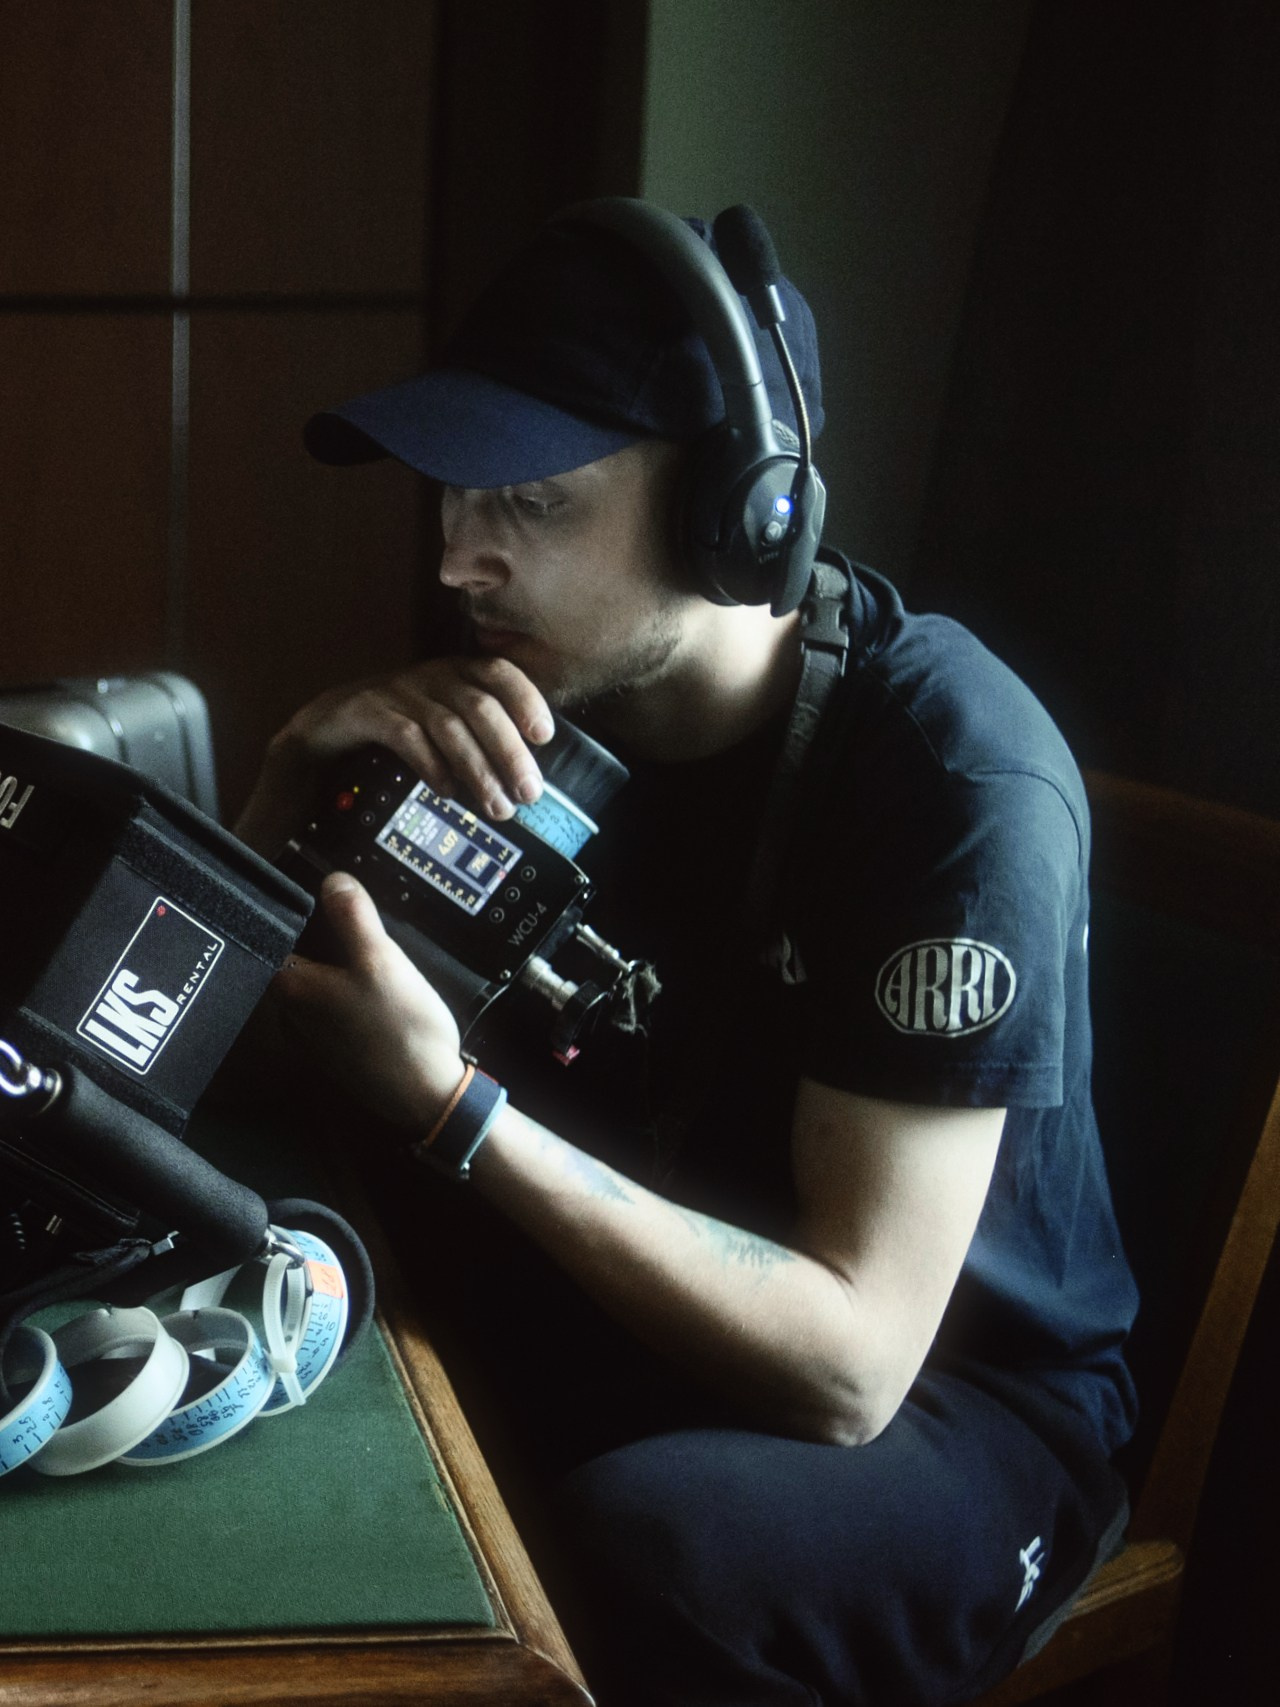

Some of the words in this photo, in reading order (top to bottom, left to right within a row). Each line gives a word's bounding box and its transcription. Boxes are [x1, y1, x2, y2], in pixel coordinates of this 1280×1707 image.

[507, 901, 547, 946] WCU-4
[84, 968, 180, 1067] LKS
[176, 943, 218, 1005] RENTAL
[885, 944, 998, 1031] ARRI
